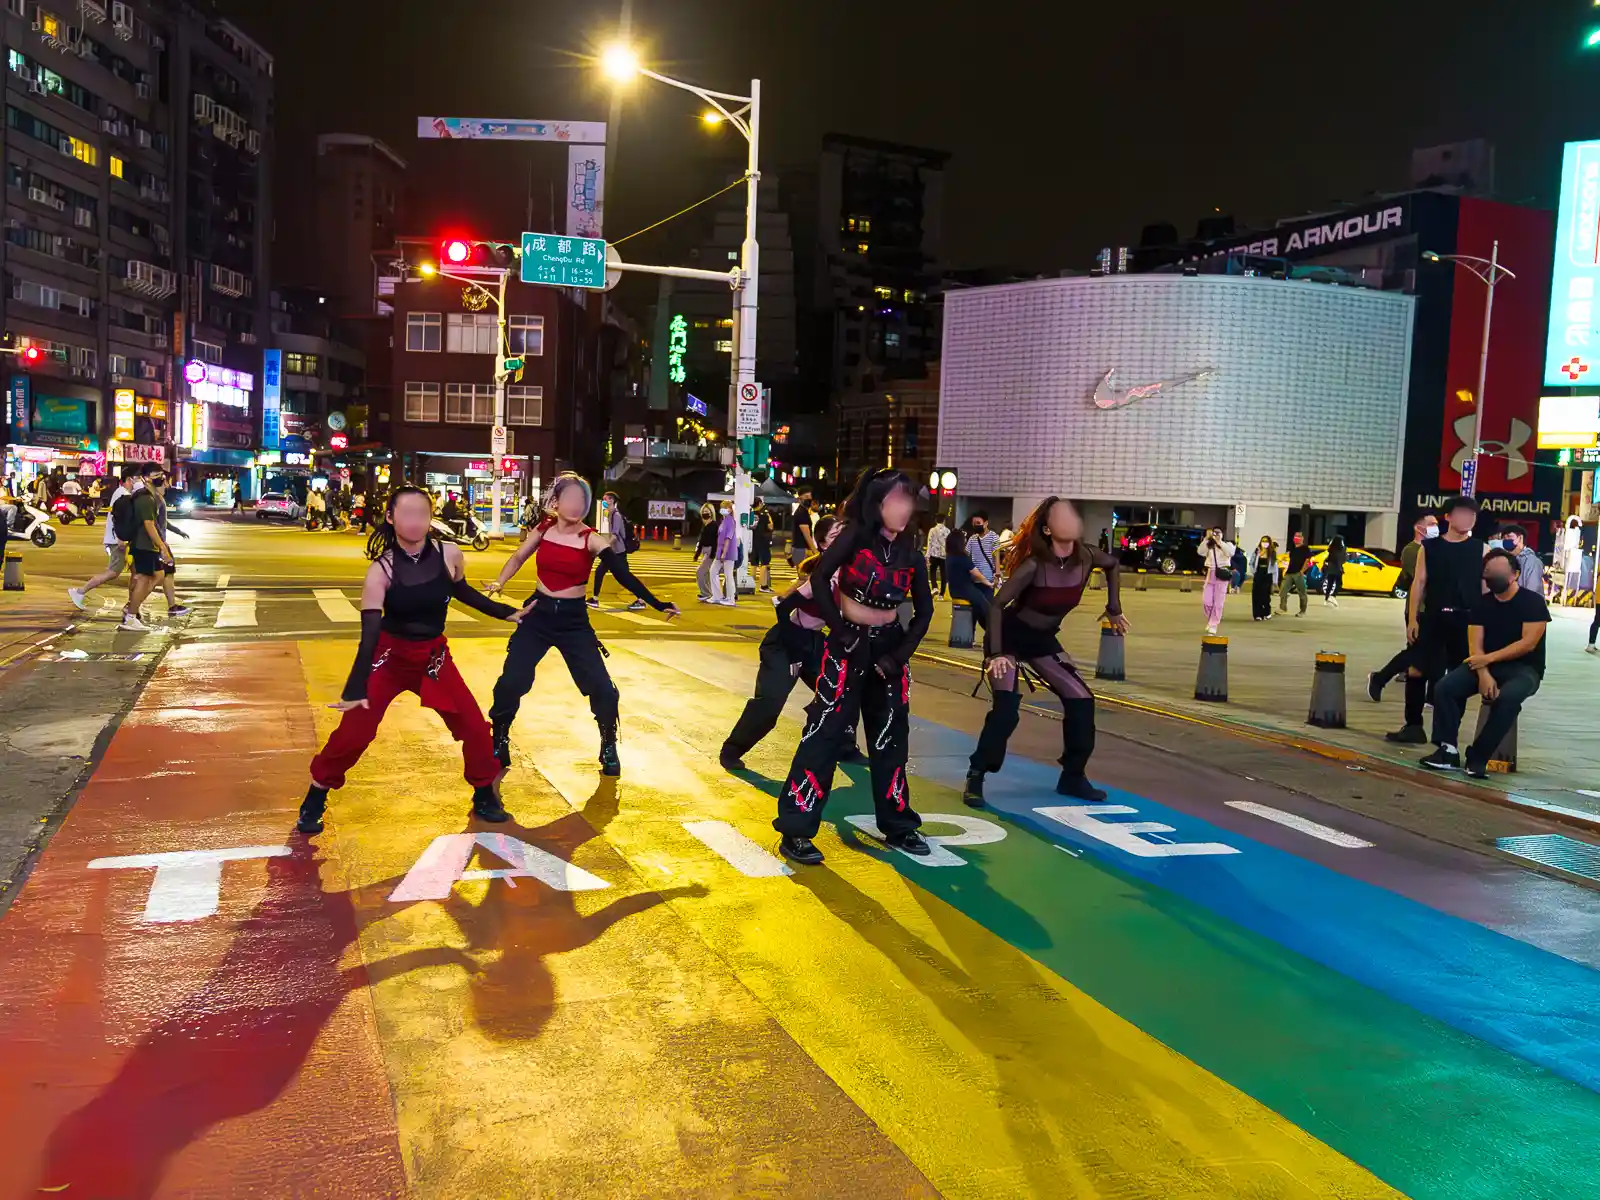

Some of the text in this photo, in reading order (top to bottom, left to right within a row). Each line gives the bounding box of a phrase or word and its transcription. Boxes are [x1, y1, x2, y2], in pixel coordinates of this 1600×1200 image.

[1284, 206, 1403, 253] ARMOUR
[532, 237, 596, 256] 成都路
[543, 255, 585, 265] ChengDu Rd
[1480, 498, 1551, 514] ARMOUR
